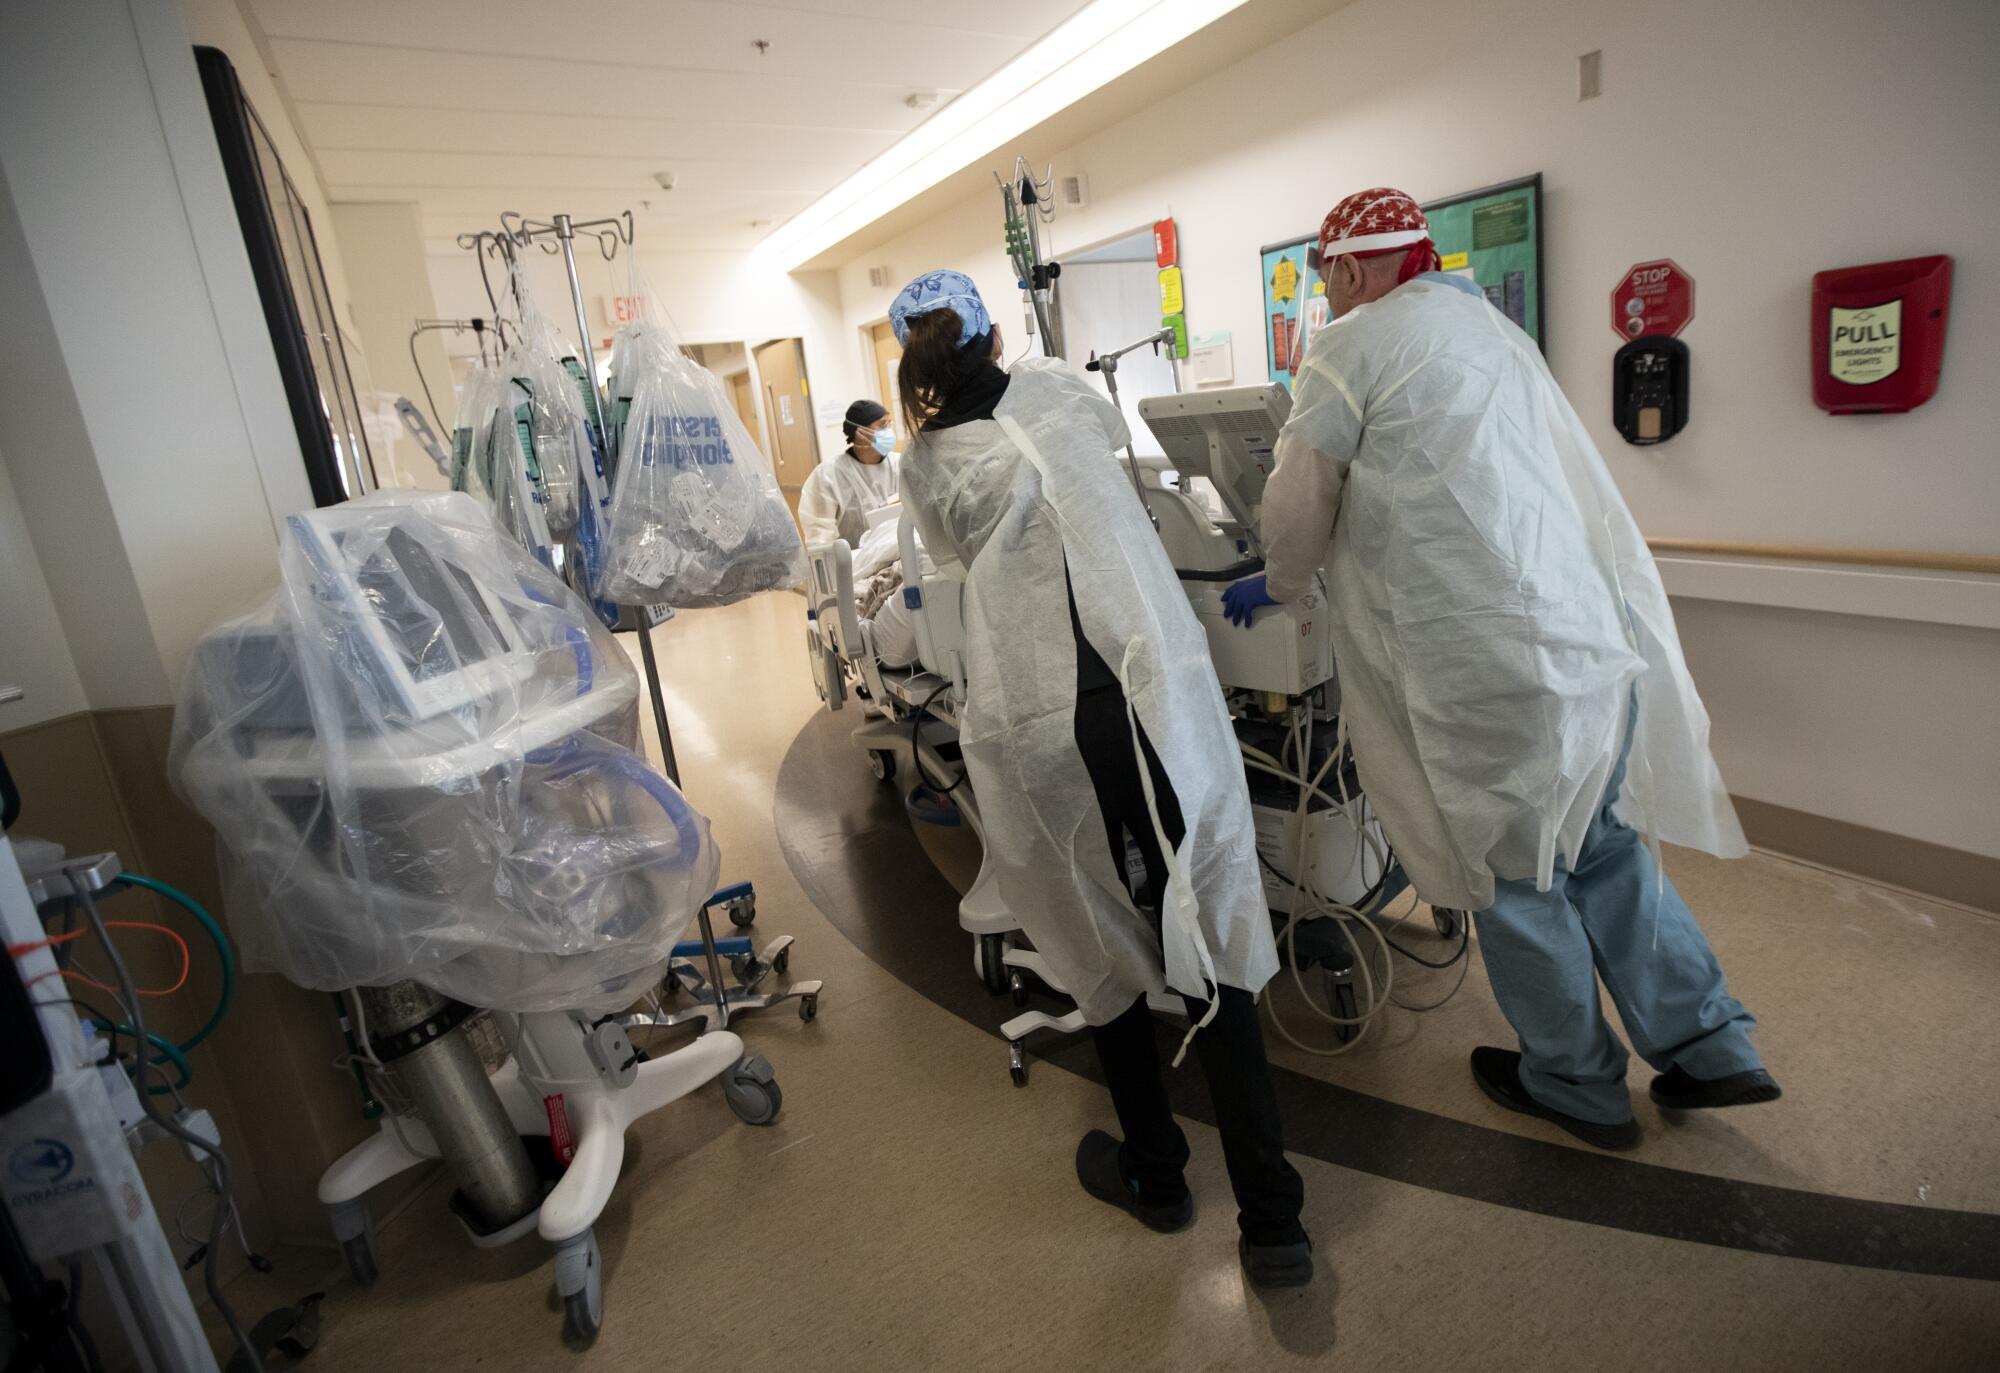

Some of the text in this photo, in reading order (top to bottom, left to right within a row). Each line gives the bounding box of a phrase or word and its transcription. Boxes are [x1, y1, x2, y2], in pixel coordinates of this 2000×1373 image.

[1631, 267, 1672, 286] STOP
[613, 295, 648, 321] EXI
[1834, 321, 1897, 343] PULL
[1835, 345, 1895, 357] EMERGENCY
[1846, 357, 1882, 367] LIGHTS
[1300, 620, 1313, 637] 07
